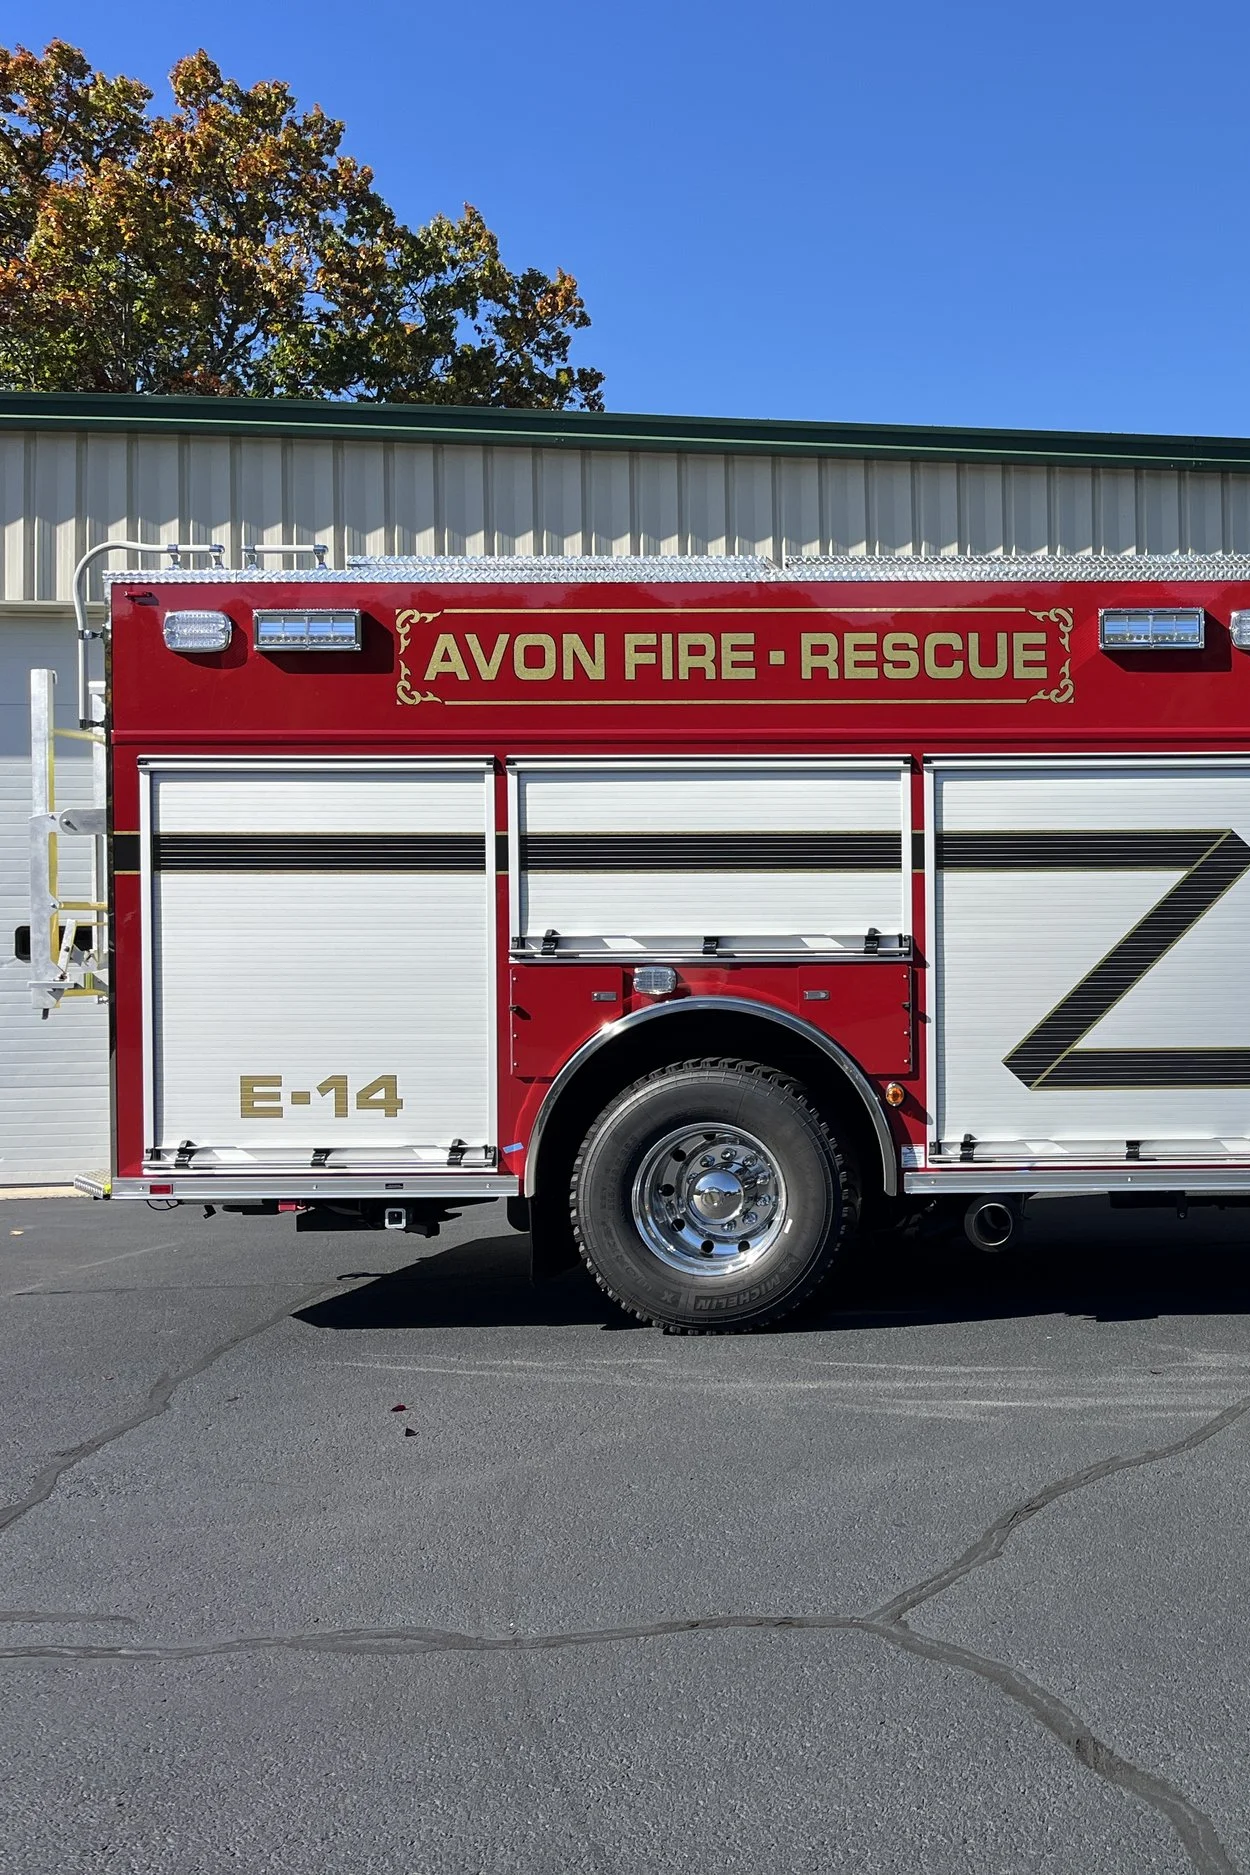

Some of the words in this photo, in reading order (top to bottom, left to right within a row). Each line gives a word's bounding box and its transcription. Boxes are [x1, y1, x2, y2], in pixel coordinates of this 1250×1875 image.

[424, 633, 605, 681] AVON
[624, 632, 756, 680] FIRE
[801, 632, 1047, 680] RESCUE
[240, 1076, 402, 1117] E-14
[696, 1273, 782, 1311] MICHELIN
